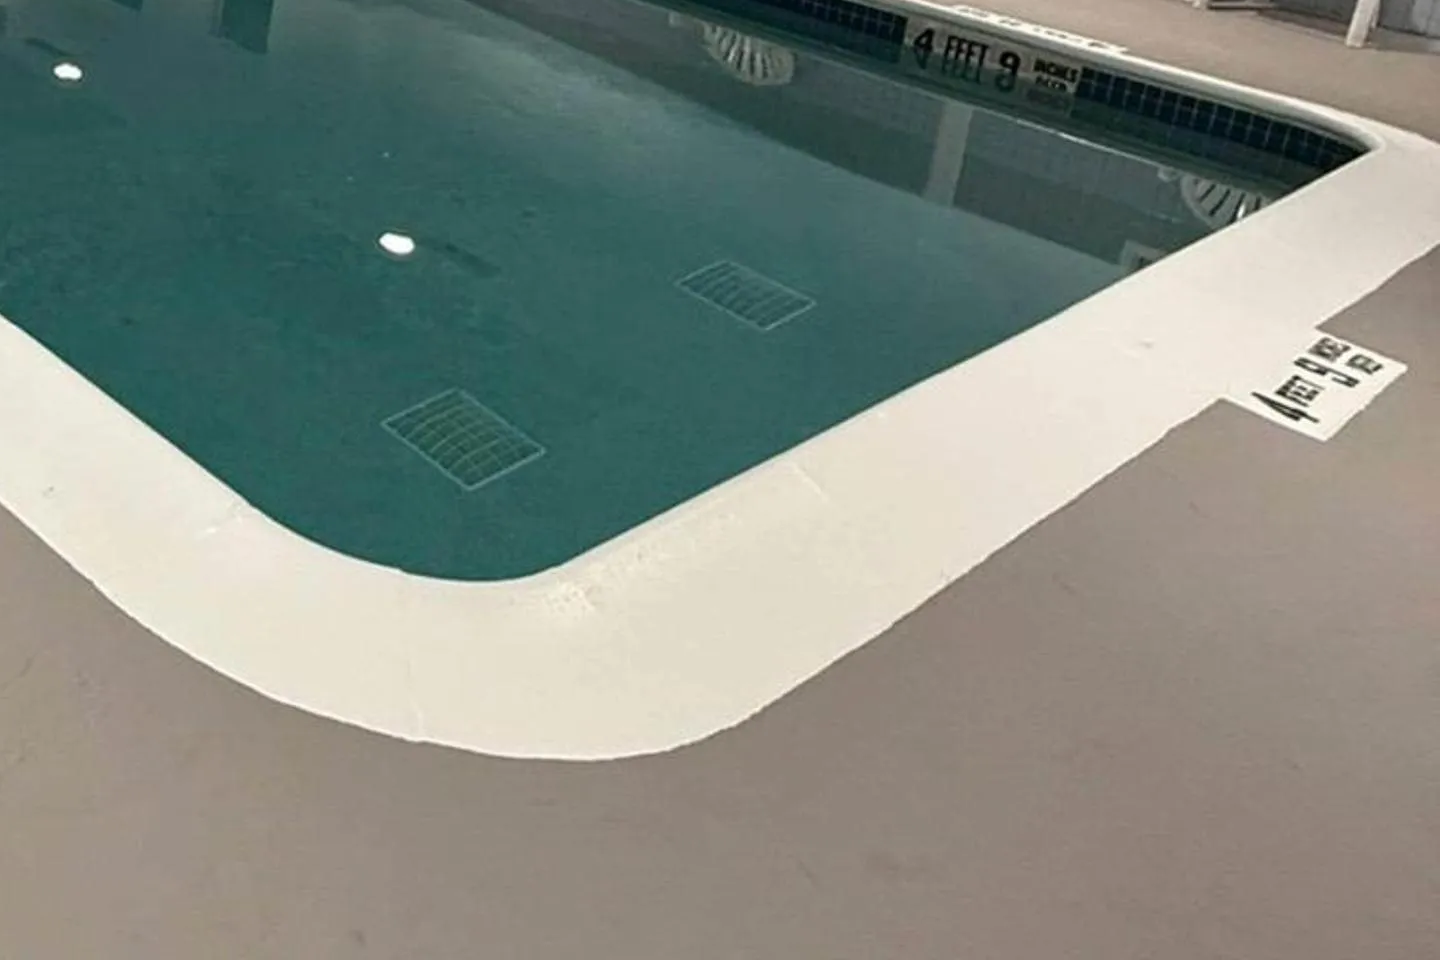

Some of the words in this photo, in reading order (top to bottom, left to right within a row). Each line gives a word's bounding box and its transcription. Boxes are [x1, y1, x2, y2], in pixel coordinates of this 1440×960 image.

[913, 26, 935, 54] 4
[998, 50, 1021, 77] 9
[1250, 391, 1320, 424] 4
[1273, 373, 1327, 408] FEET
